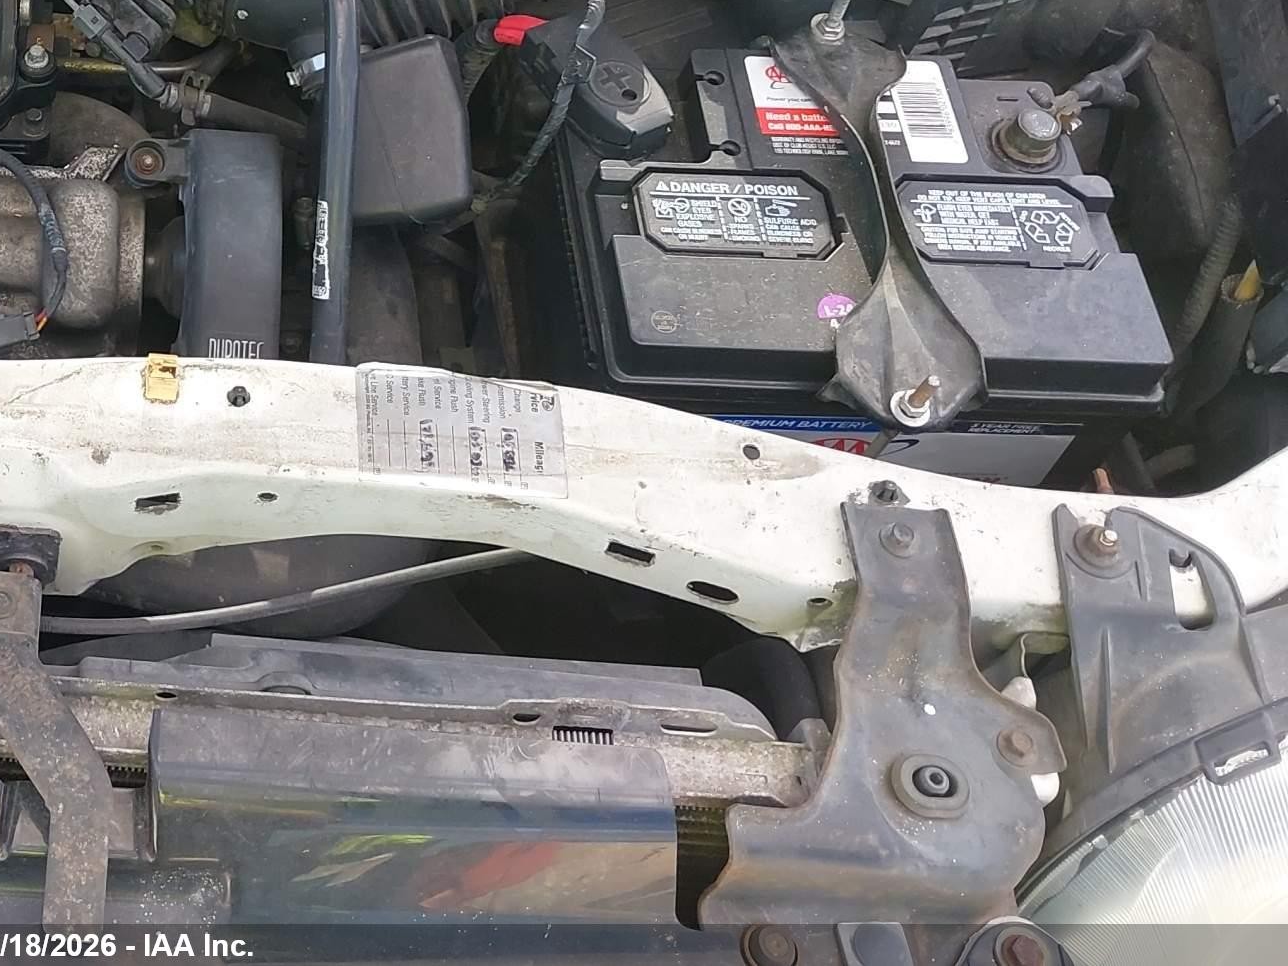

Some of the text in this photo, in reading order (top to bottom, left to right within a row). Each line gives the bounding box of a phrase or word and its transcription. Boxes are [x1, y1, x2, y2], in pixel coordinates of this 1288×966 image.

[765, 112, 791, 121] Need
[669, 181, 799, 196] DANGER / POISON
[796, 420, 873, 429] BATTERY
